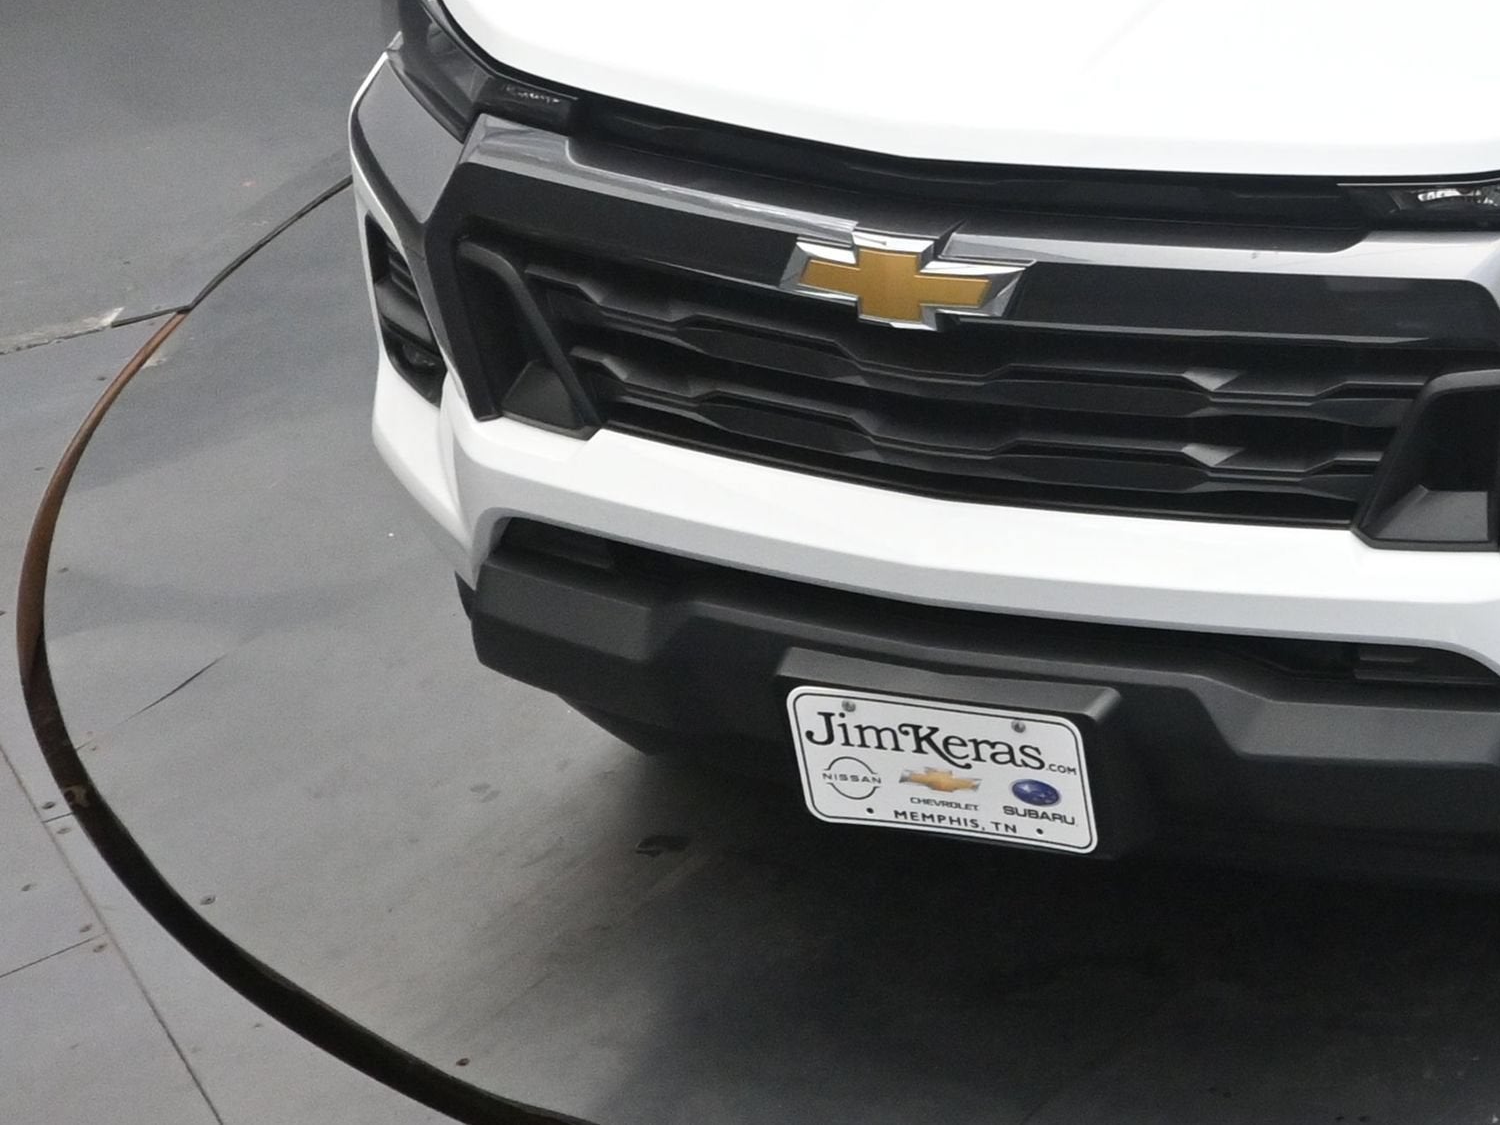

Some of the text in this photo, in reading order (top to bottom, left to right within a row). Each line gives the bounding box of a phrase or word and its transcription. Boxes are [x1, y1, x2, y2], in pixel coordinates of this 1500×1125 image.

[822, 773, 882, 784] NISSAN
[910, 797, 979, 811] CHEVROLET
[893, 810, 1017, 834] MEMPHIS, TN
[1003, 805, 1075, 825] SUBARU
